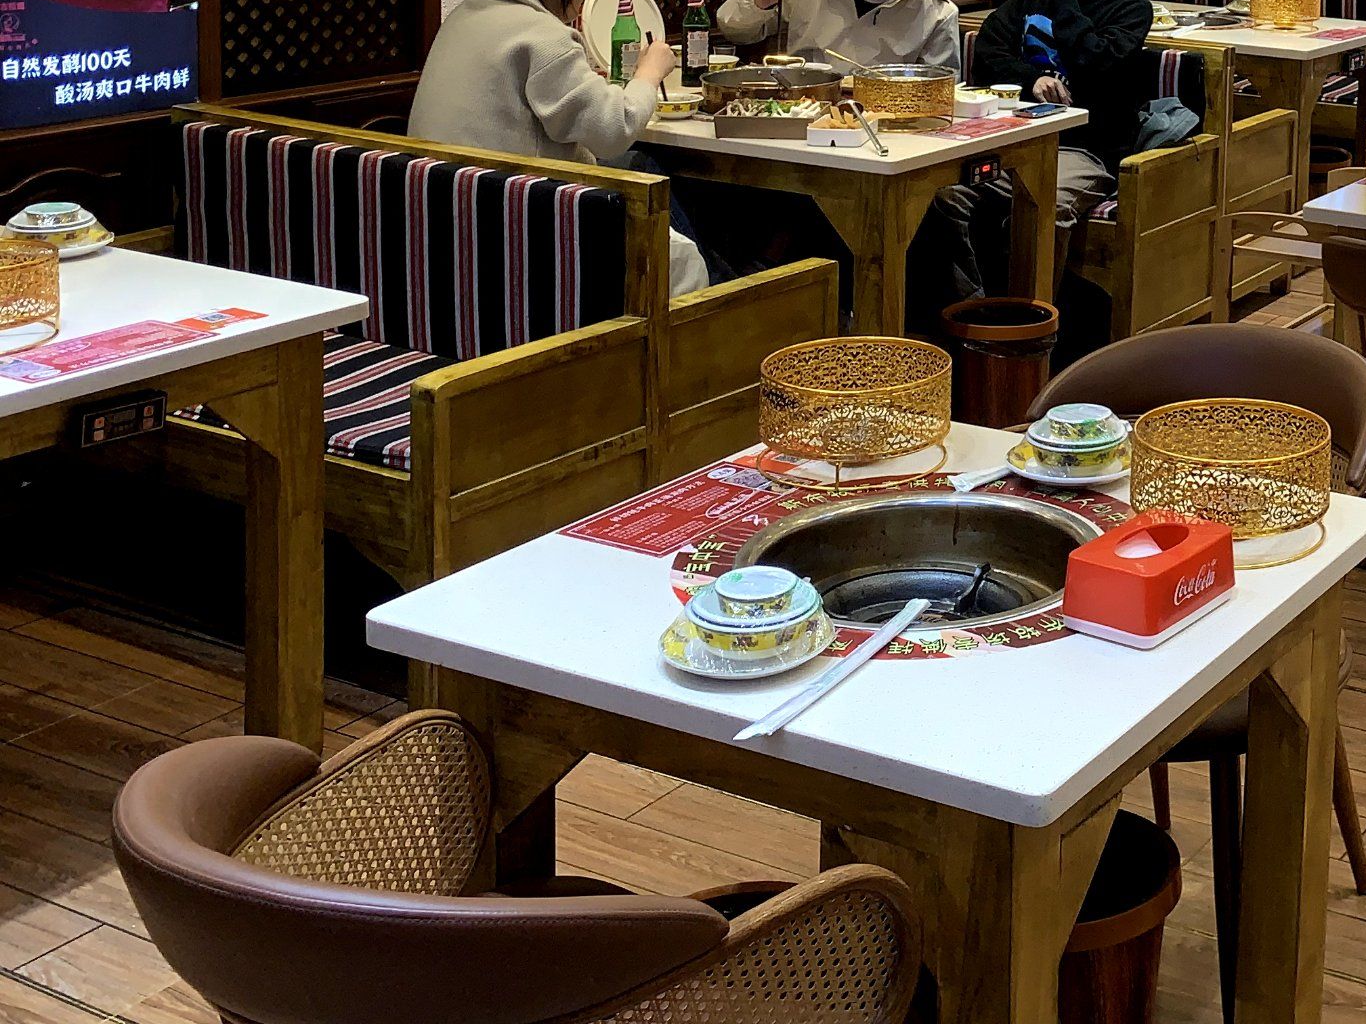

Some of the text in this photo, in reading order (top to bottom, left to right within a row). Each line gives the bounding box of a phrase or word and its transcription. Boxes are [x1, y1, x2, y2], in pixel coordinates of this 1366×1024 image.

[2, 48, 132, 80] 自然发酵100天
[55, 68, 190, 105] 酸汤爽口牛肉鲜
